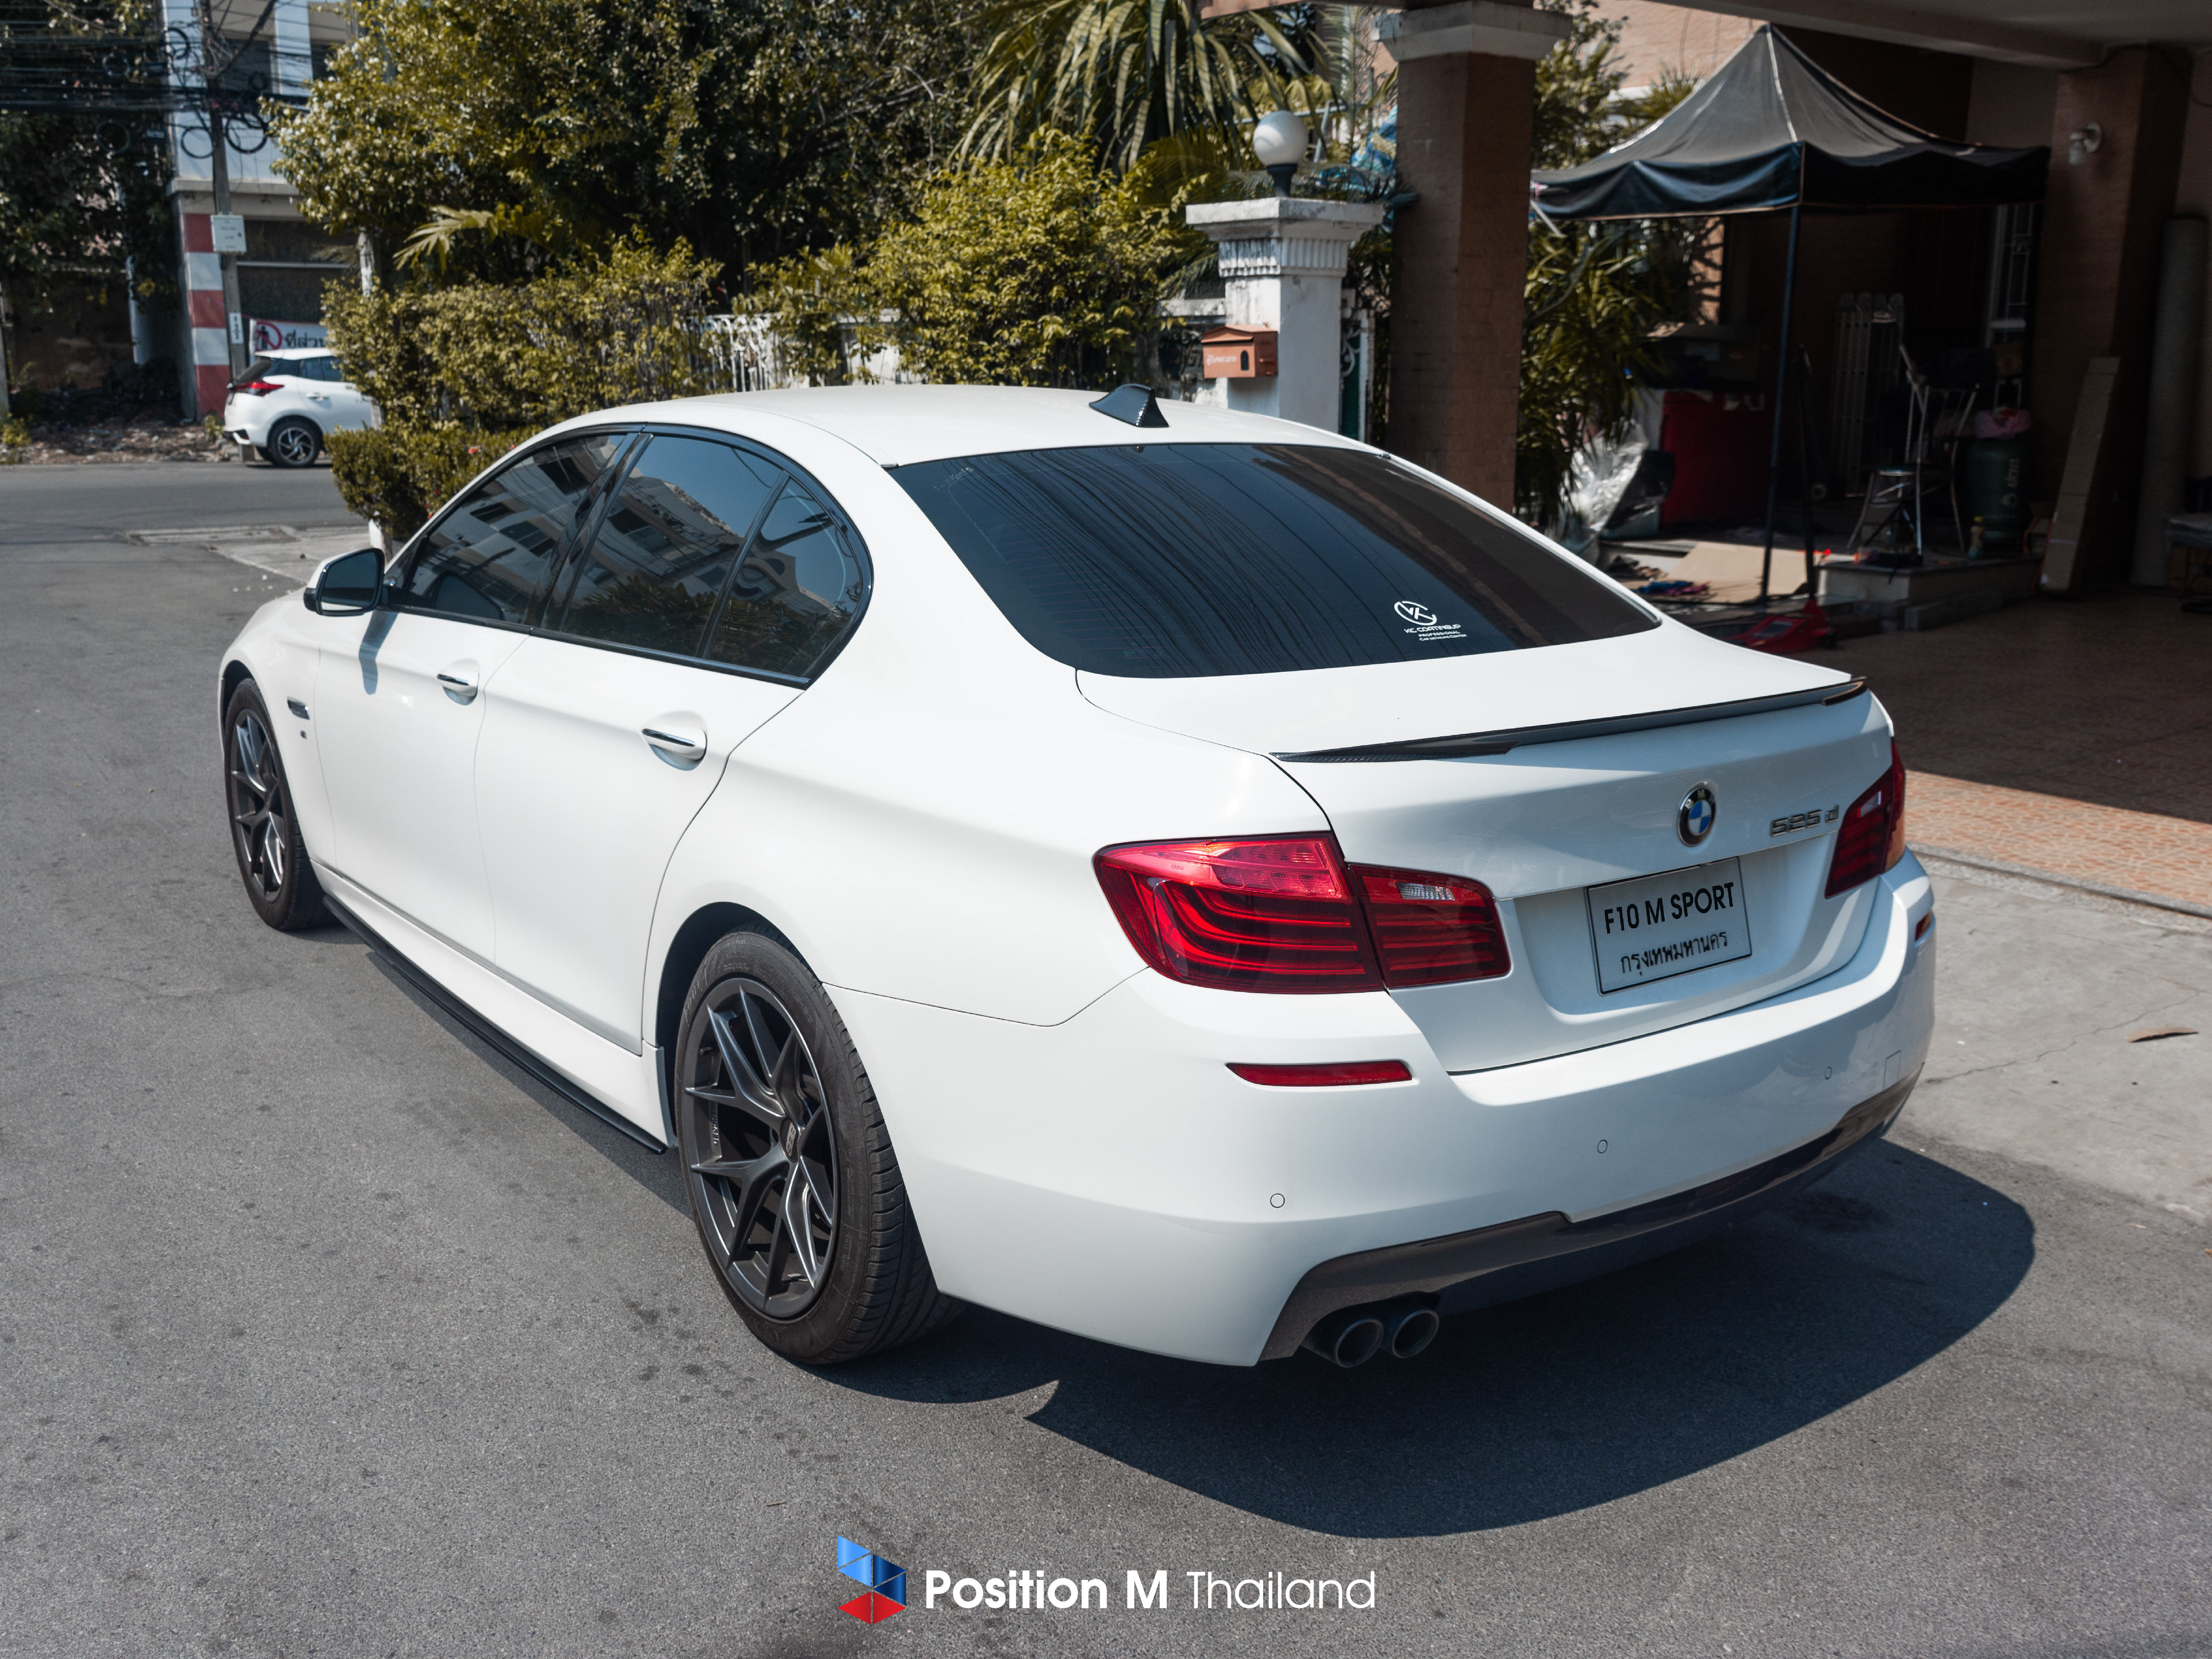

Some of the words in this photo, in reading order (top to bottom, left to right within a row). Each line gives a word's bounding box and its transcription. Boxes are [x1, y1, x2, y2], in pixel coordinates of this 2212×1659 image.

[1770, 809, 1822, 837] 525
[1825, 805, 1839, 823] d
[1604, 904, 1639, 934] F10
[1645, 897, 1665, 925] M
[1671, 881, 1734, 919] SPORT
[1621, 931, 1728, 976] กรุงเทพมหานคร
[786, 1122, 797, 1157] BBS
